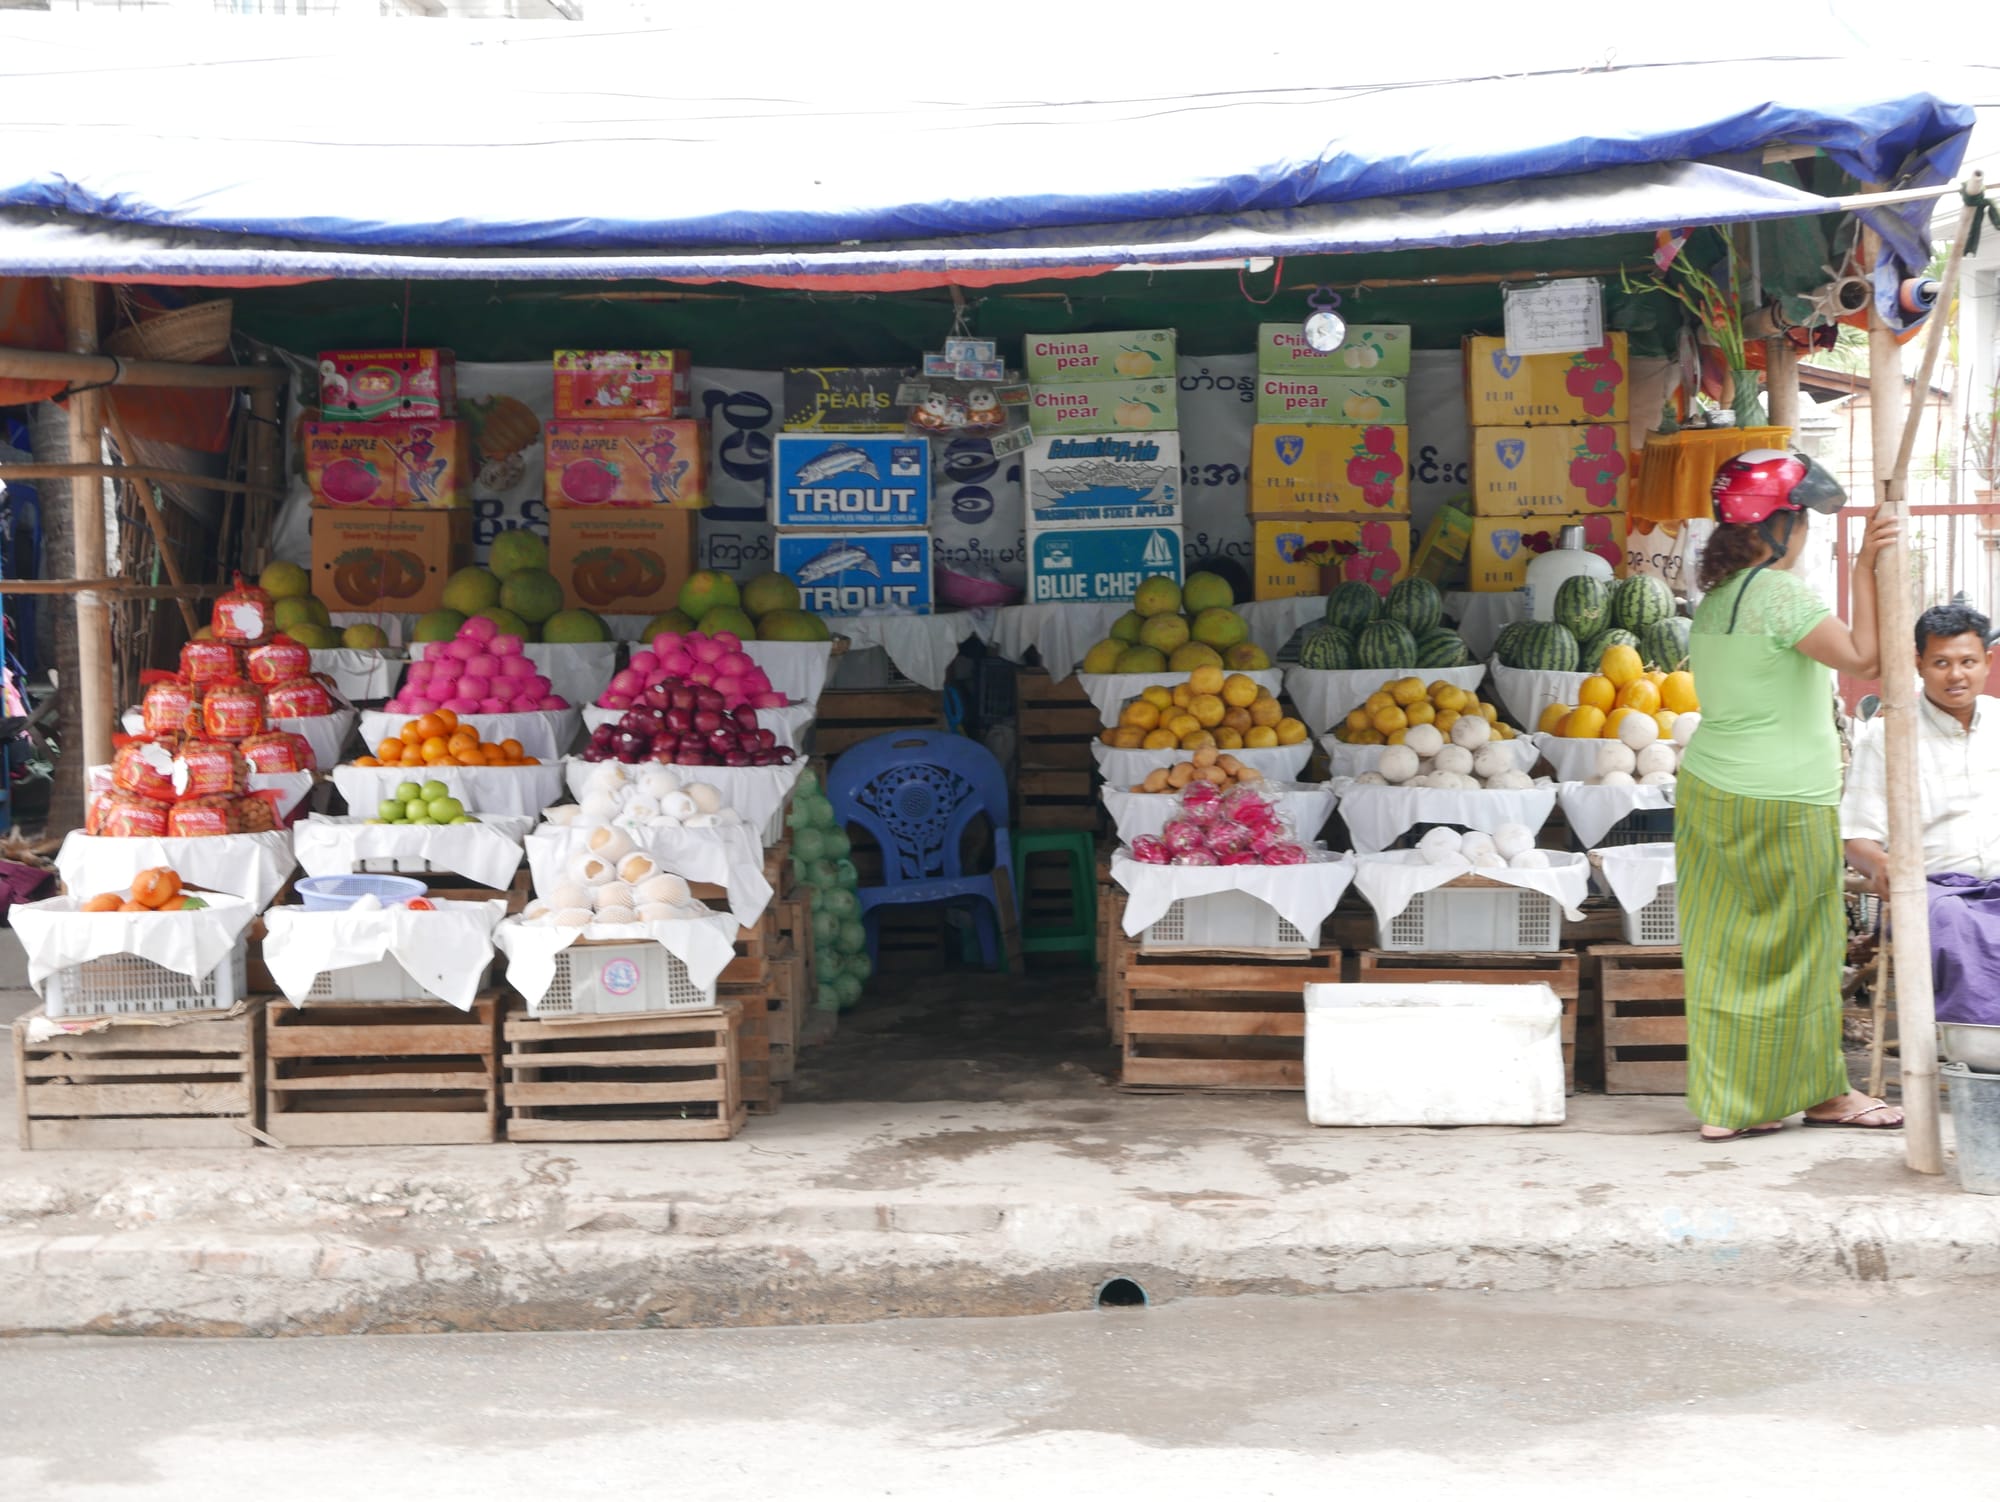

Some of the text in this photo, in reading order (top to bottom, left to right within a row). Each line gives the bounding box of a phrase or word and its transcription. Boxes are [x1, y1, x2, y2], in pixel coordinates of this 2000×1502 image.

[1273, 332, 1306, 346] Chi
[1035, 342, 1088, 356] China
[1057, 356, 1099, 370] pear
[1264, 382, 1318, 395] China
[816, 392, 890, 408] PEARS
[1035, 393, 1088, 407] China
[1286, 396, 1328, 411] pear
[1057, 407, 1099, 422] pear
[312, 438, 377, 450] PING APPLE
[552, 439, 618, 450] PING APPLE
[788, 488, 916, 512] TROUT
[1102, 506, 1134, 518] STATE
[1037, 571, 1176, 599] BLUE CHEL
[798, 586, 917, 611] TROUT
